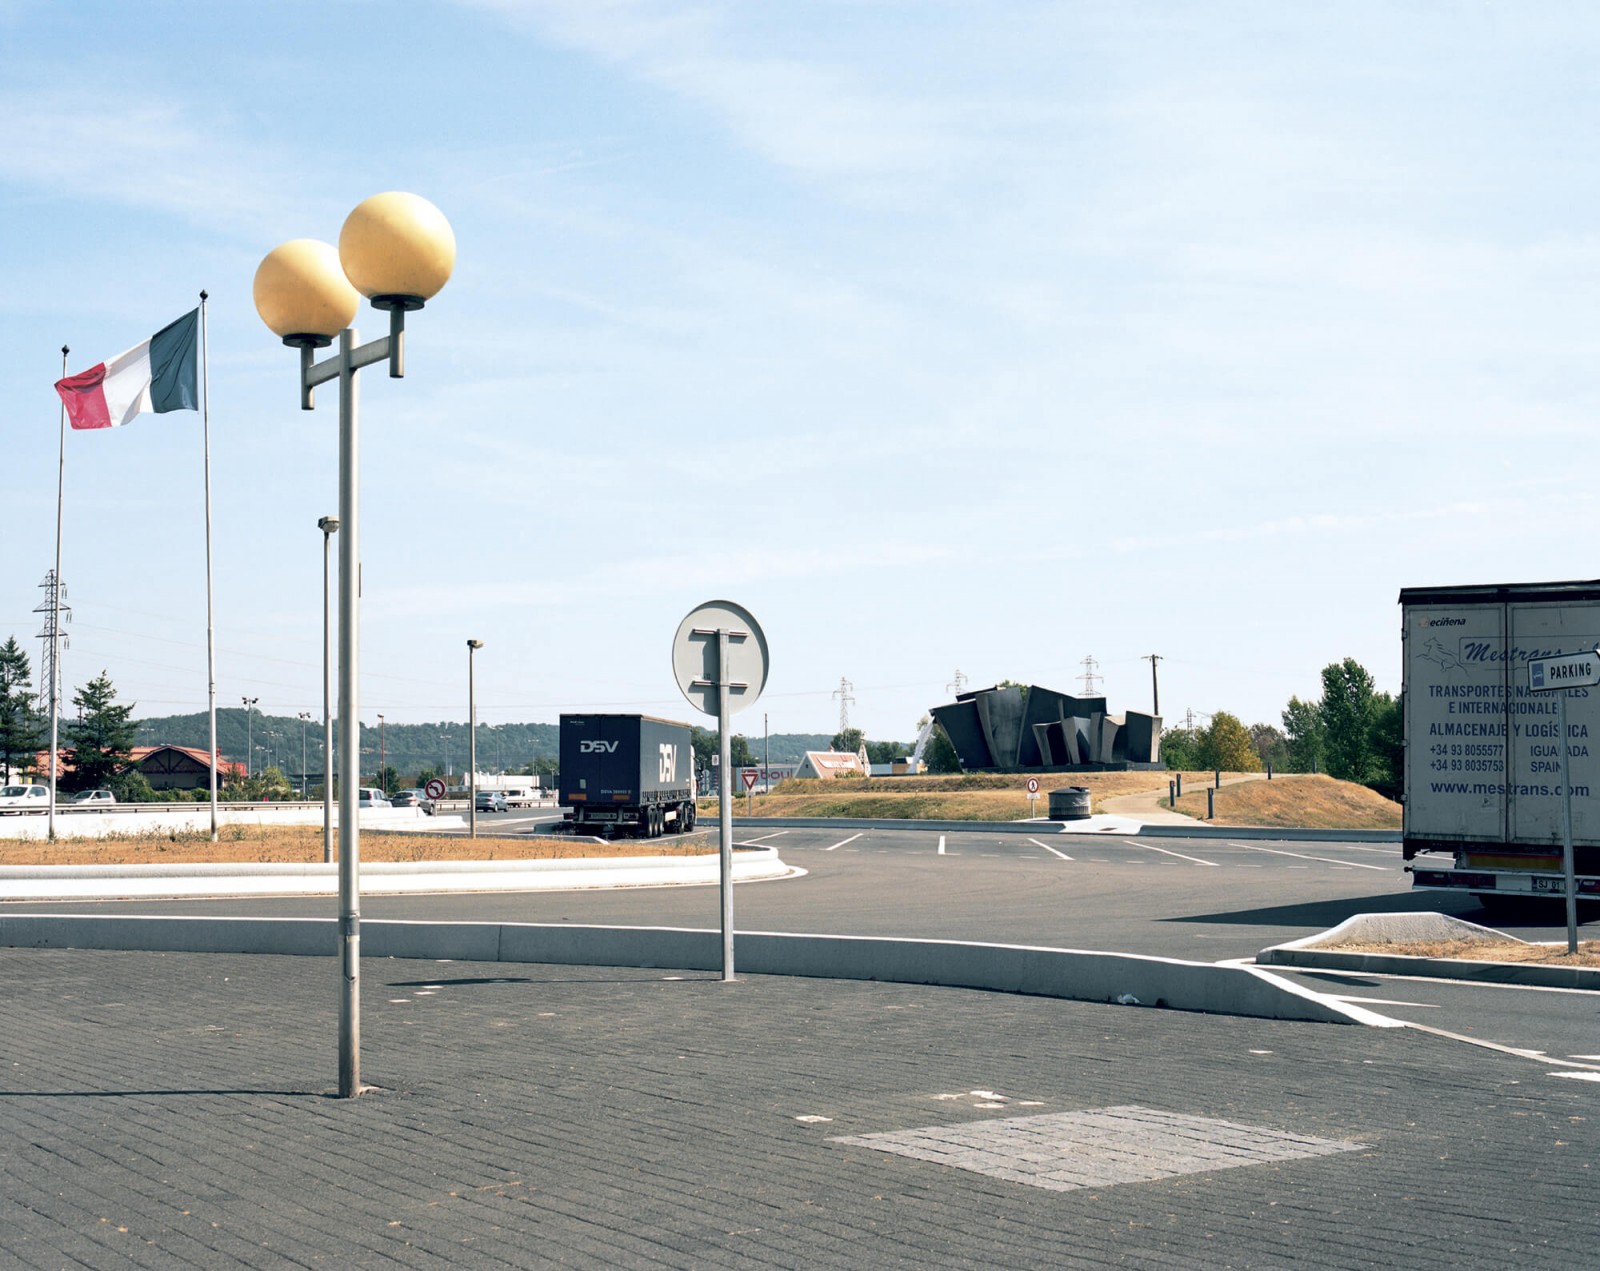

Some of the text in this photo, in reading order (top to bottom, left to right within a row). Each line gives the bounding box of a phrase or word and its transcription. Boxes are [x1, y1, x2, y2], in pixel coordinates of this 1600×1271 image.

[1550, 662, 1591, 680] PARKING
[1429, 685, 1512, 698] TRANSPORTES
[1449, 702, 1559, 715] E INTERNACIONALE
[1429, 721, 1588, 738] ALMACENAJE Y LOGÍSICA
[580, 740, 619, 753] DSV
[1430, 744, 1504, 757] +34 93 8055577
[1530, 745, 1589, 757] IGUAADA
[659, 743, 677, 783] DSV
[1430, 759, 1448, 771] +34
[1451, 759, 1462, 771] 93
[1530, 761, 1561, 773] SPAIN
